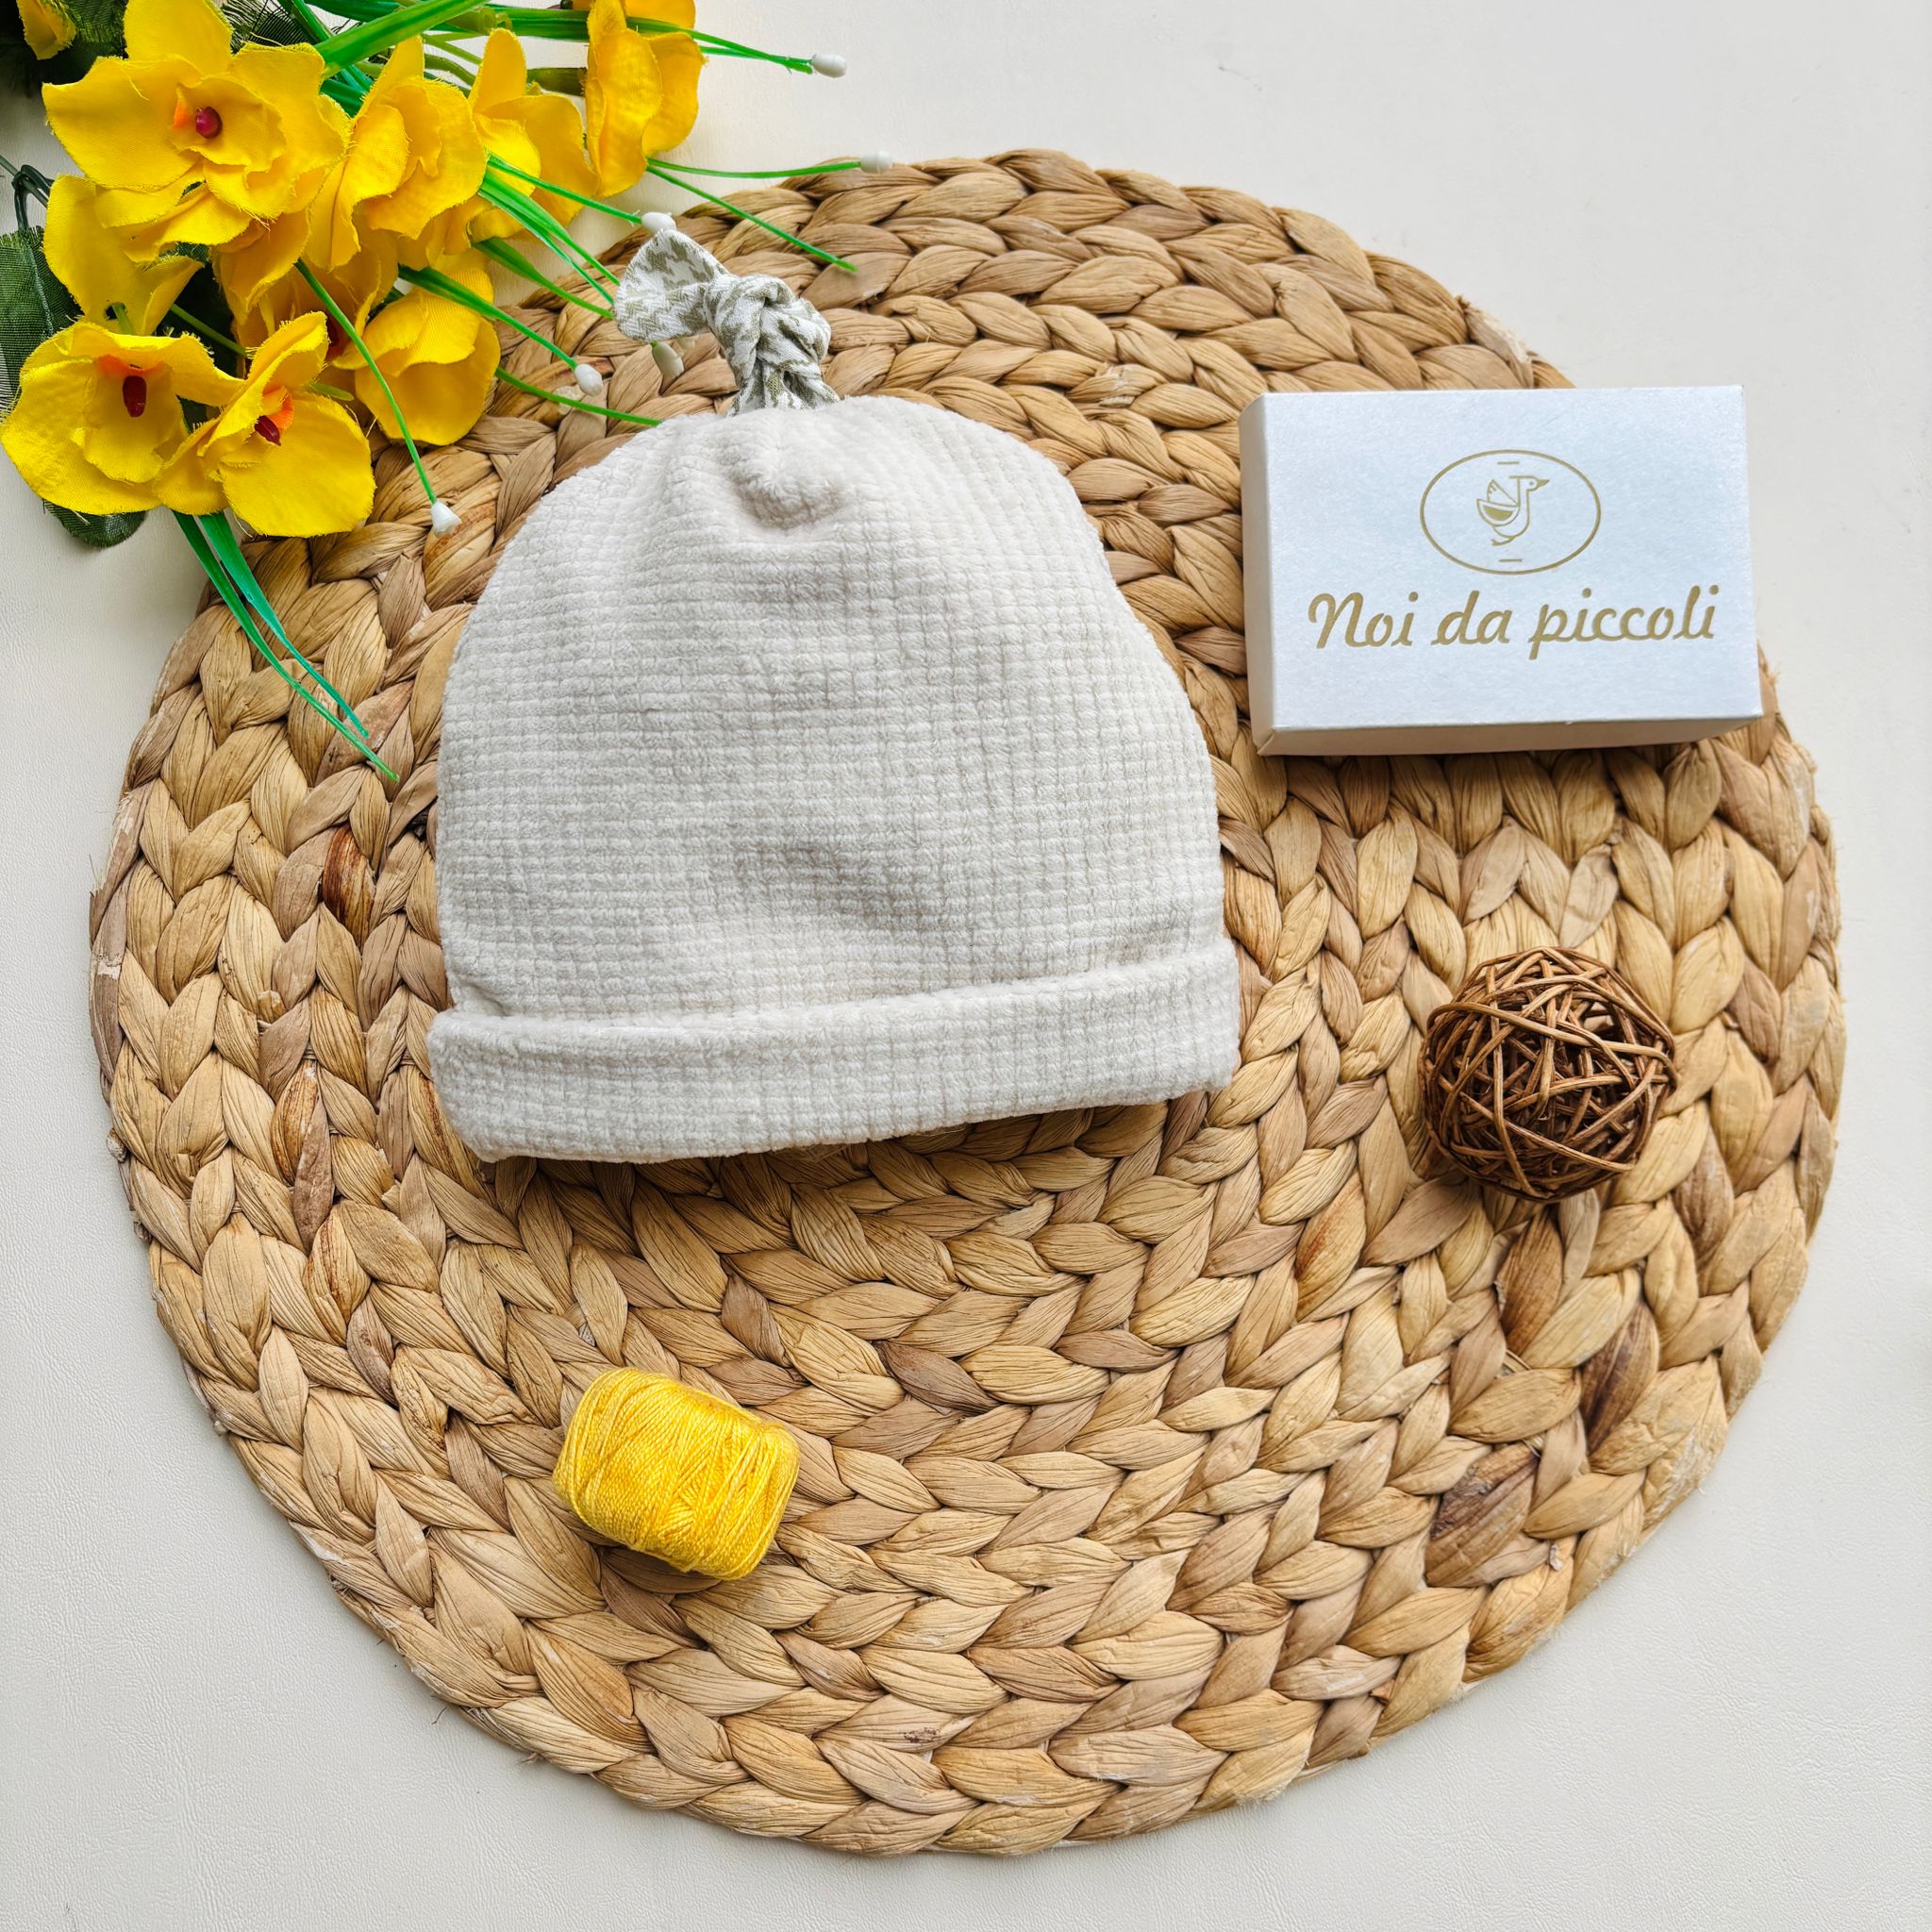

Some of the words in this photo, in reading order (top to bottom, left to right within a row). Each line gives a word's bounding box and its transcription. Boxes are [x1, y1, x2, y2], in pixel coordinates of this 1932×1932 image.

[1307, 591, 1419, 650] Noi
[1431, 590, 1512, 646] da
[1529, 585, 1720, 660] piccoli
